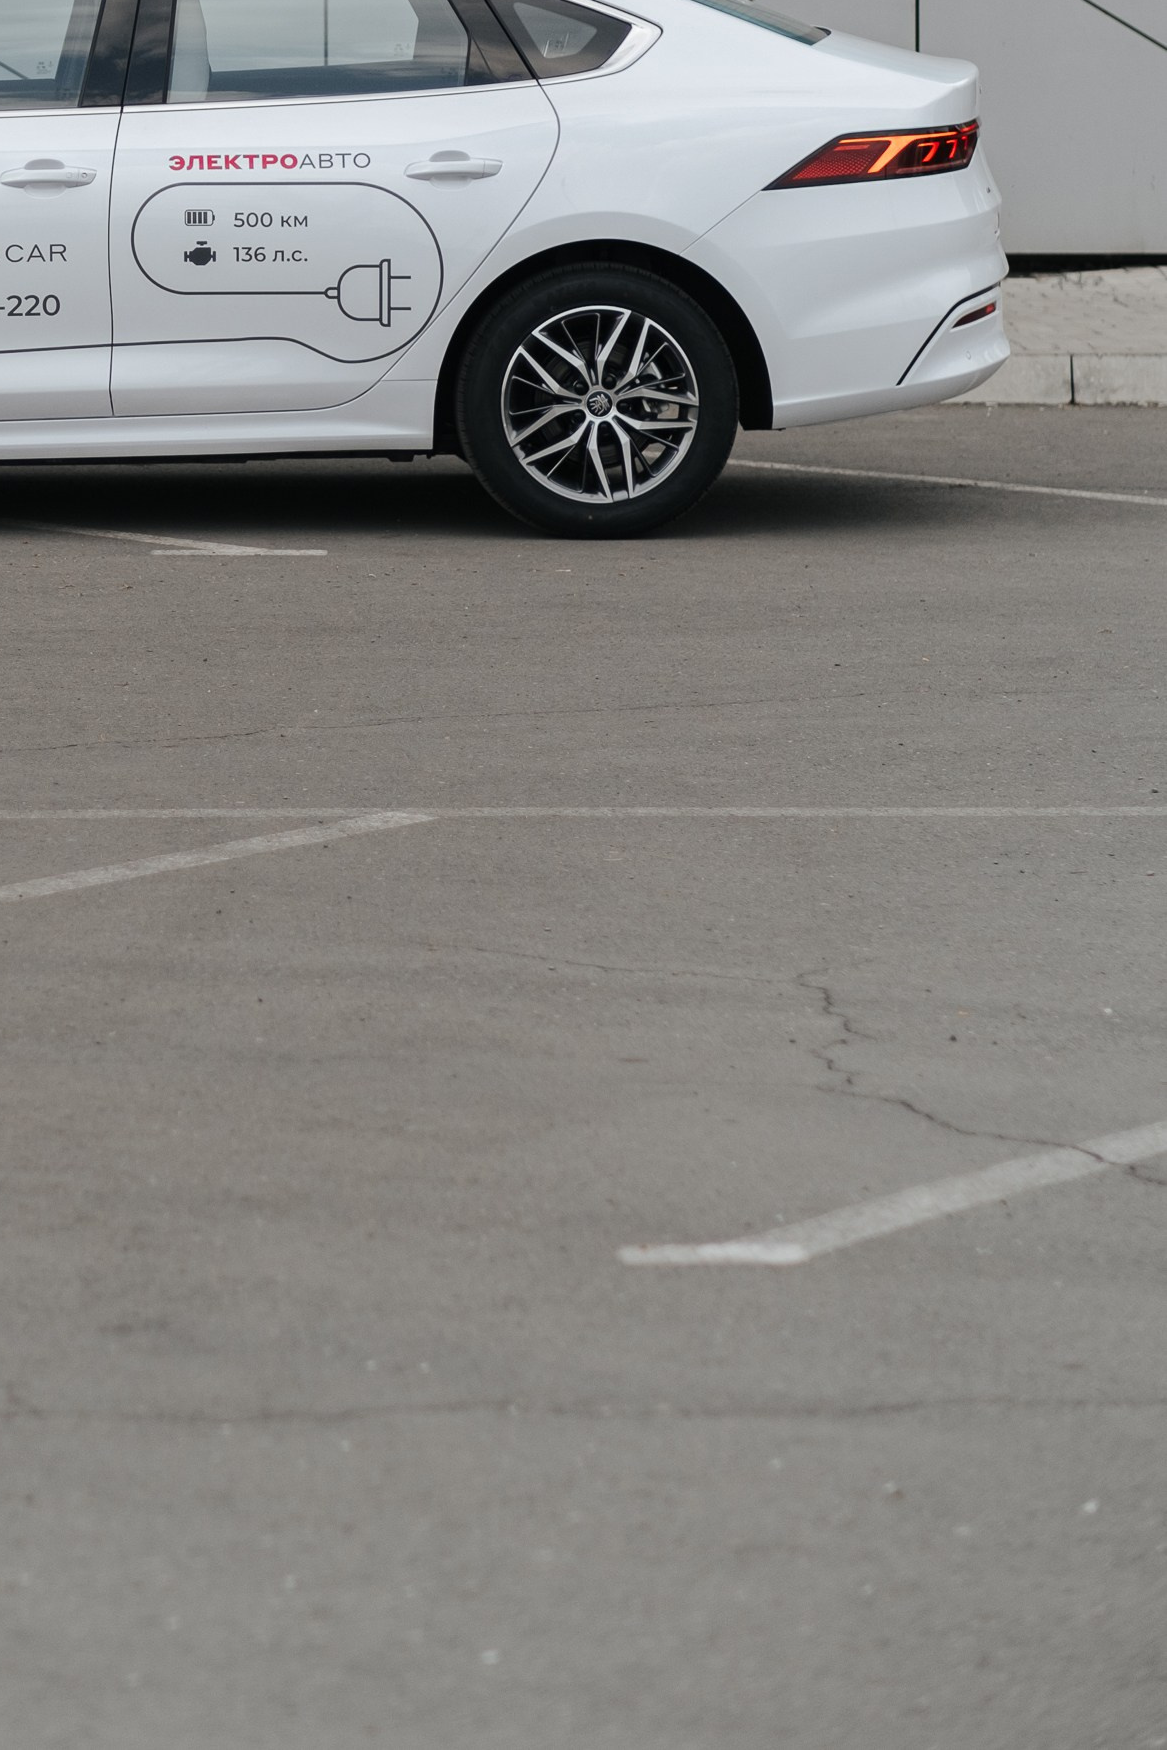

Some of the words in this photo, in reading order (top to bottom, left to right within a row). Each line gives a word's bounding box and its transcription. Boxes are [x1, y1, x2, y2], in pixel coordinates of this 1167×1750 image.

[233, 212, 274, 228] 500
[280, 215, 309, 228] км
[232, 246, 267, 263] 136
[271, 249, 309, 263] л.с.
